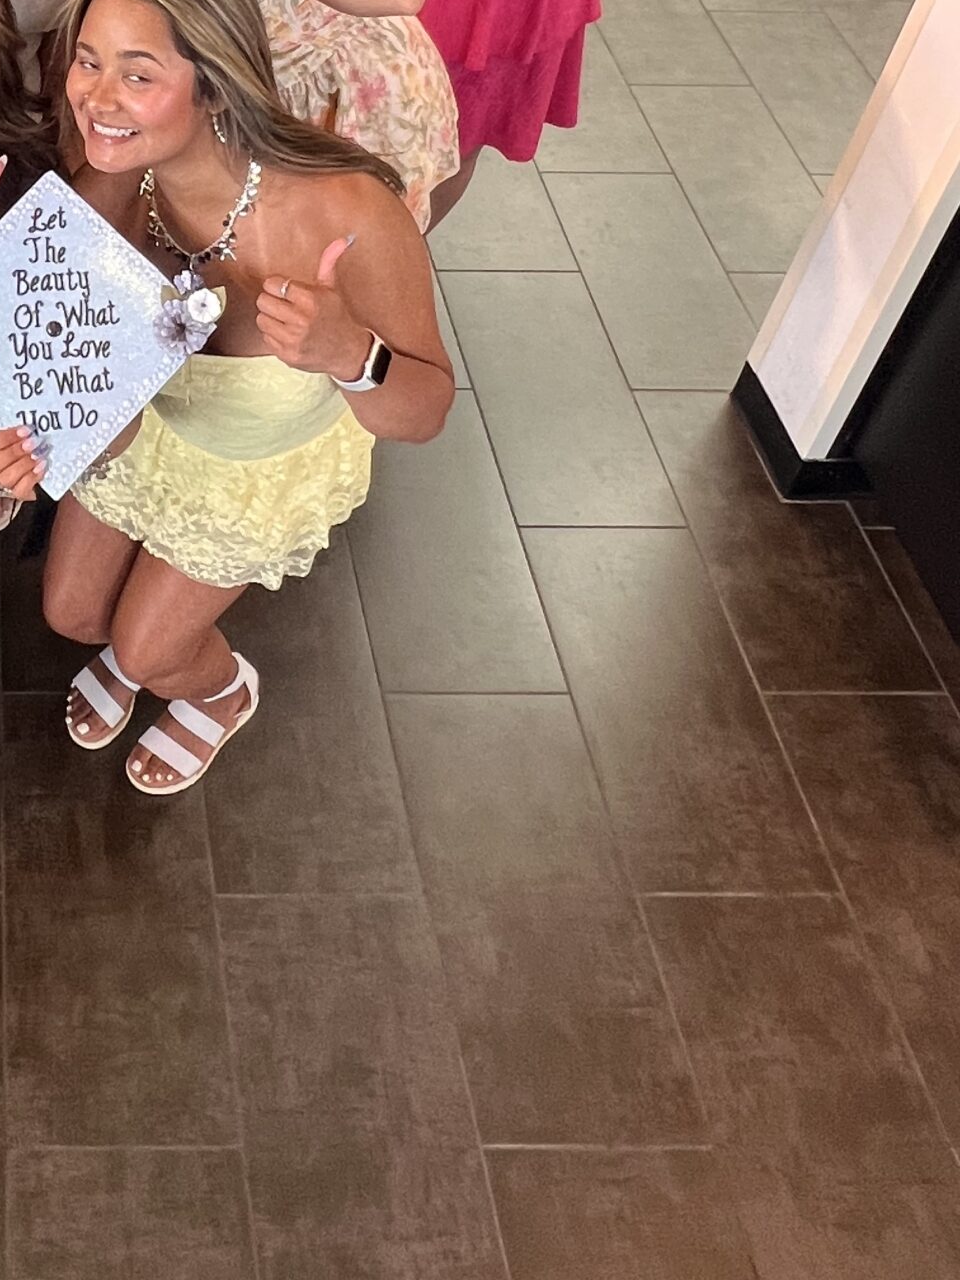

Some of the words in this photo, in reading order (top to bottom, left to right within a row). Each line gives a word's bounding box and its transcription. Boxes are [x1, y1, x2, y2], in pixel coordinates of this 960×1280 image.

[28, 206, 67, 233] Let
[23, 236, 67, 264] The
[12, 267, 90, 299] Beauty
[14, 300, 44, 330] Of
[55, 298, 121, 328] What
[8, 331, 53, 370] You
[60, 331, 111, 359] Love
[12, 372, 44, 400] Be
[46, 365, 114, 395] What
[16, 410, 62, 436] You
[65, 401, 98, 429] Do
